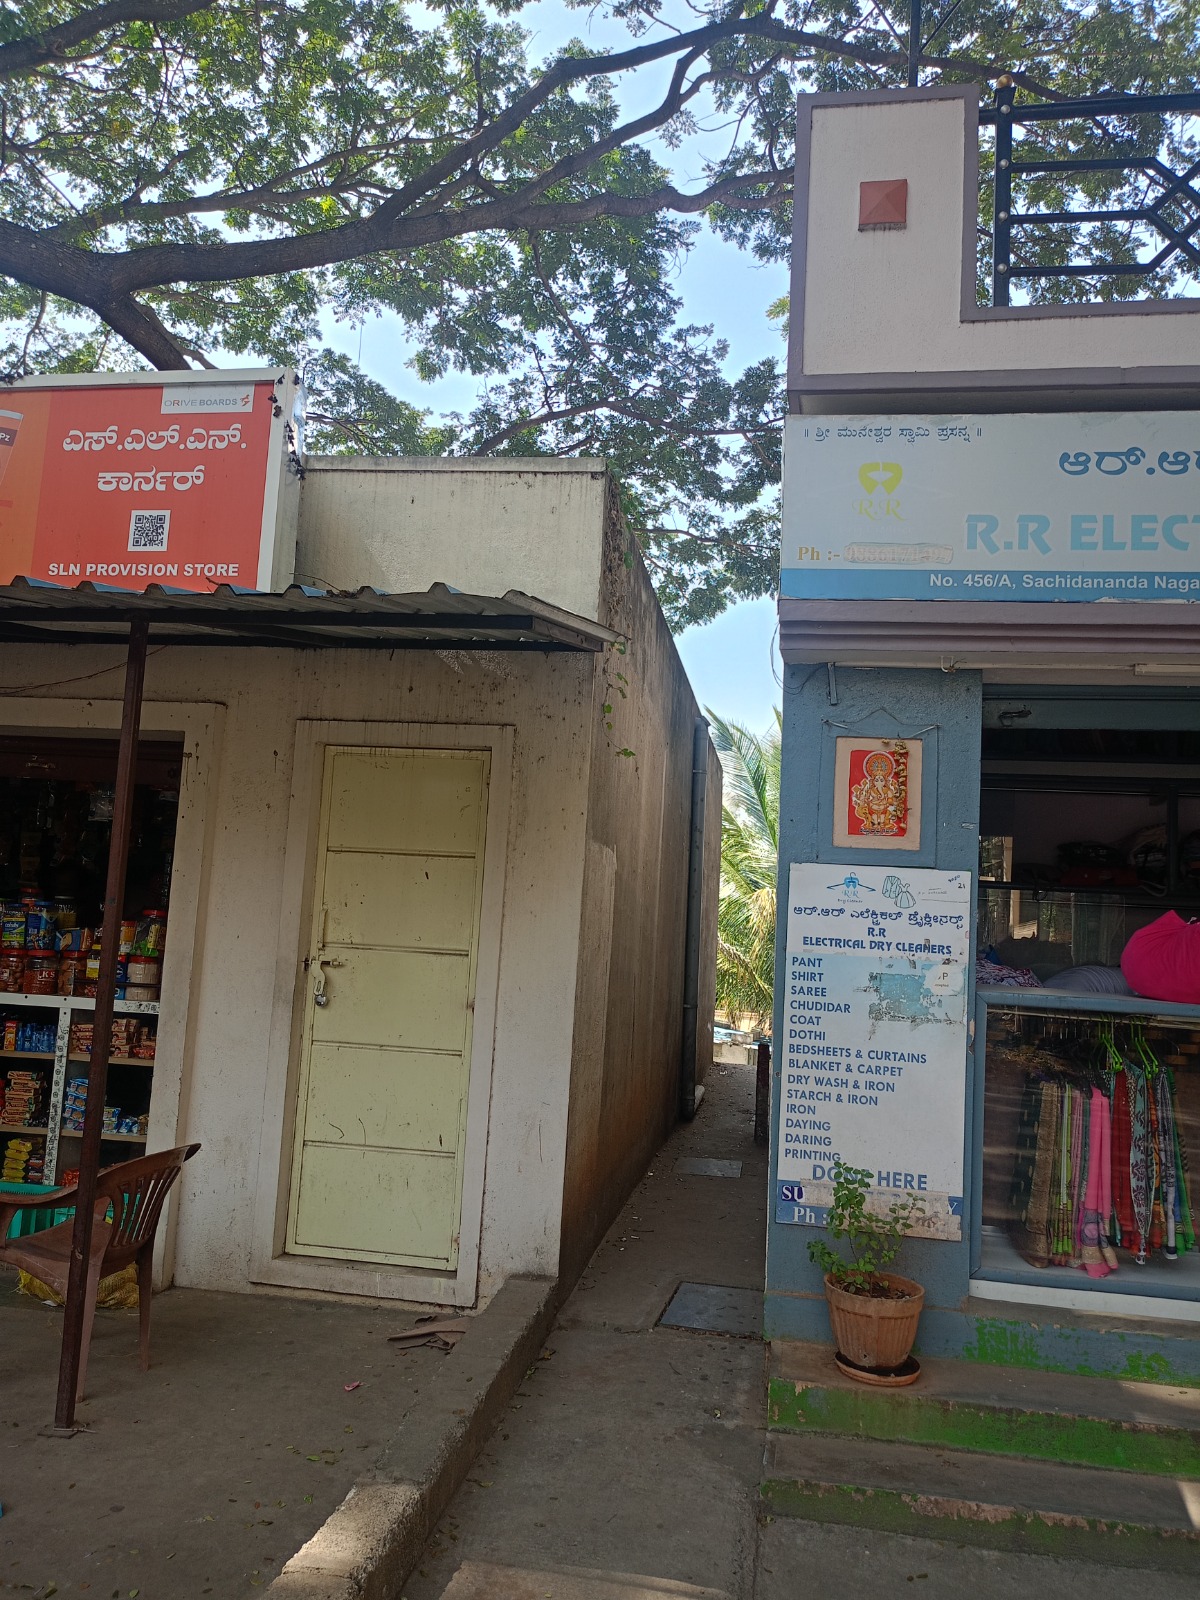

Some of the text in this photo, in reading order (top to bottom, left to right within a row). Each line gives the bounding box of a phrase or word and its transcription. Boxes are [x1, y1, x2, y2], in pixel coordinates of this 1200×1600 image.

[199, 398, 238, 406] BOARDS
[837, 425, 892, 443] ಮುನೇಶ್ವರ
[898, 426, 930, 443] ಸ್ವಾಮಿ
[937, 426, 971, 443] ಪ್ರಸನ್ನ
[1058, 446, 1200, 476] ಆರ್.ಆ
[97, 464, 205, 492] ಕಾರ್ನರ್
[965, 514, 1052, 556] R.R
[1070, 514, 1200, 551] ELEC
[797, 546, 820, 561] Ph
[48, 563, 239, 577] SLN PROVISION STORE
[930, 573, 958, 587] No.
[962, 574, 1016, 590] 456/A,
[1022, 574, 1148, 589] Sachidananda
[867, 927, 887, 938] R.R
[802, 936, 866, 950] ELECTRICAL
[869, 940, 892, 952] DRY
[792, 956, 822, 968] PANT
[791, 972, 824, 982] SHIRT
[790, 986, 827, 997] SAREE
[790, 1000, 851, 1014] CHUDIDAR
[790, 1014, 822, 1026] COAT
[789, 1029, 826, 1042] DOTHI
[788, 1044, 927, 1064] BEDSHEETS & CURTAINS
[788, 1058, 904, 1077] BLANKET & CARPET
[788, 1074, 895, 1092] DRY WASH & IRON
[786, 1089, 878, 1106] STARCH & IRON
[786, 1104, 816, 1115] IRON
[786, 1118, 831, 1132] DAYING
[785, 1133, 832, 1146] DARING
[784, 1148, 842, 1162] PRINTING
[812, 1164, 928, 1190] DO HERE
[792, 1206, 816, 1224] Ph
